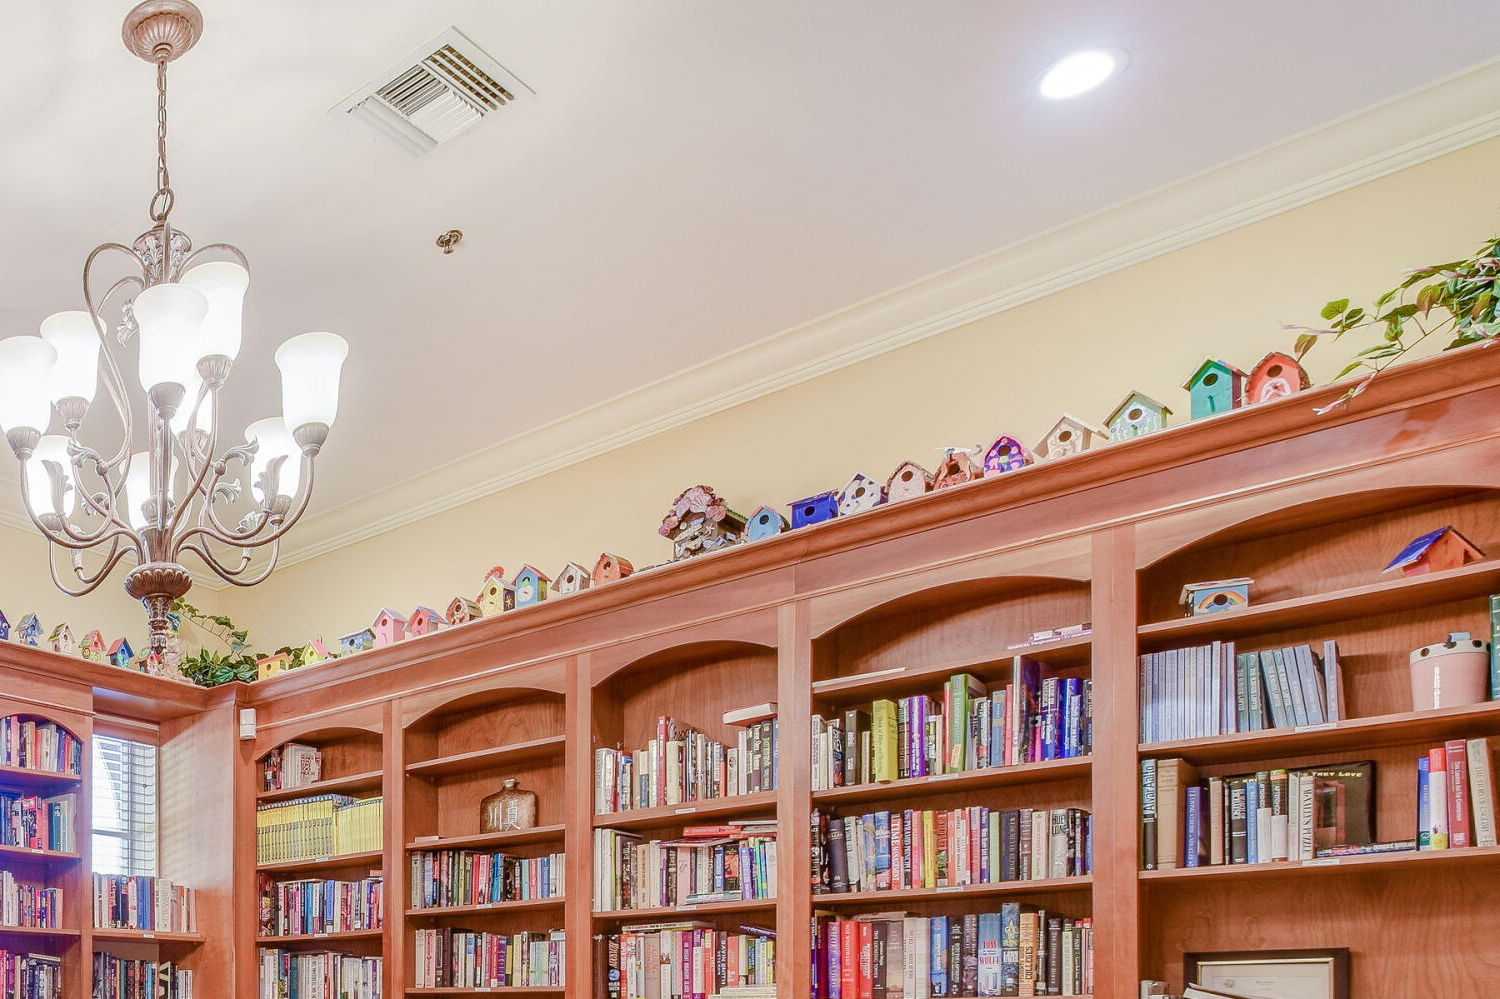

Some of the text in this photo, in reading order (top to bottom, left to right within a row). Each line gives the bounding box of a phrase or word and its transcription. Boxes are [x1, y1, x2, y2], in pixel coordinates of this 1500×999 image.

[1475, 766, 1485, 778] THE
[1146, 765, 1154, 811] Alvar Aalto
[1477, 780, 1486, 795] STORY
[1052, 815, 1066, 824] HUEY
[1302, 789, 1312, 854] McNALLY'S PUZZLE
[1052, 825, 1068, 834] LONG
[980, 956, 1000, 964] WOLFE
